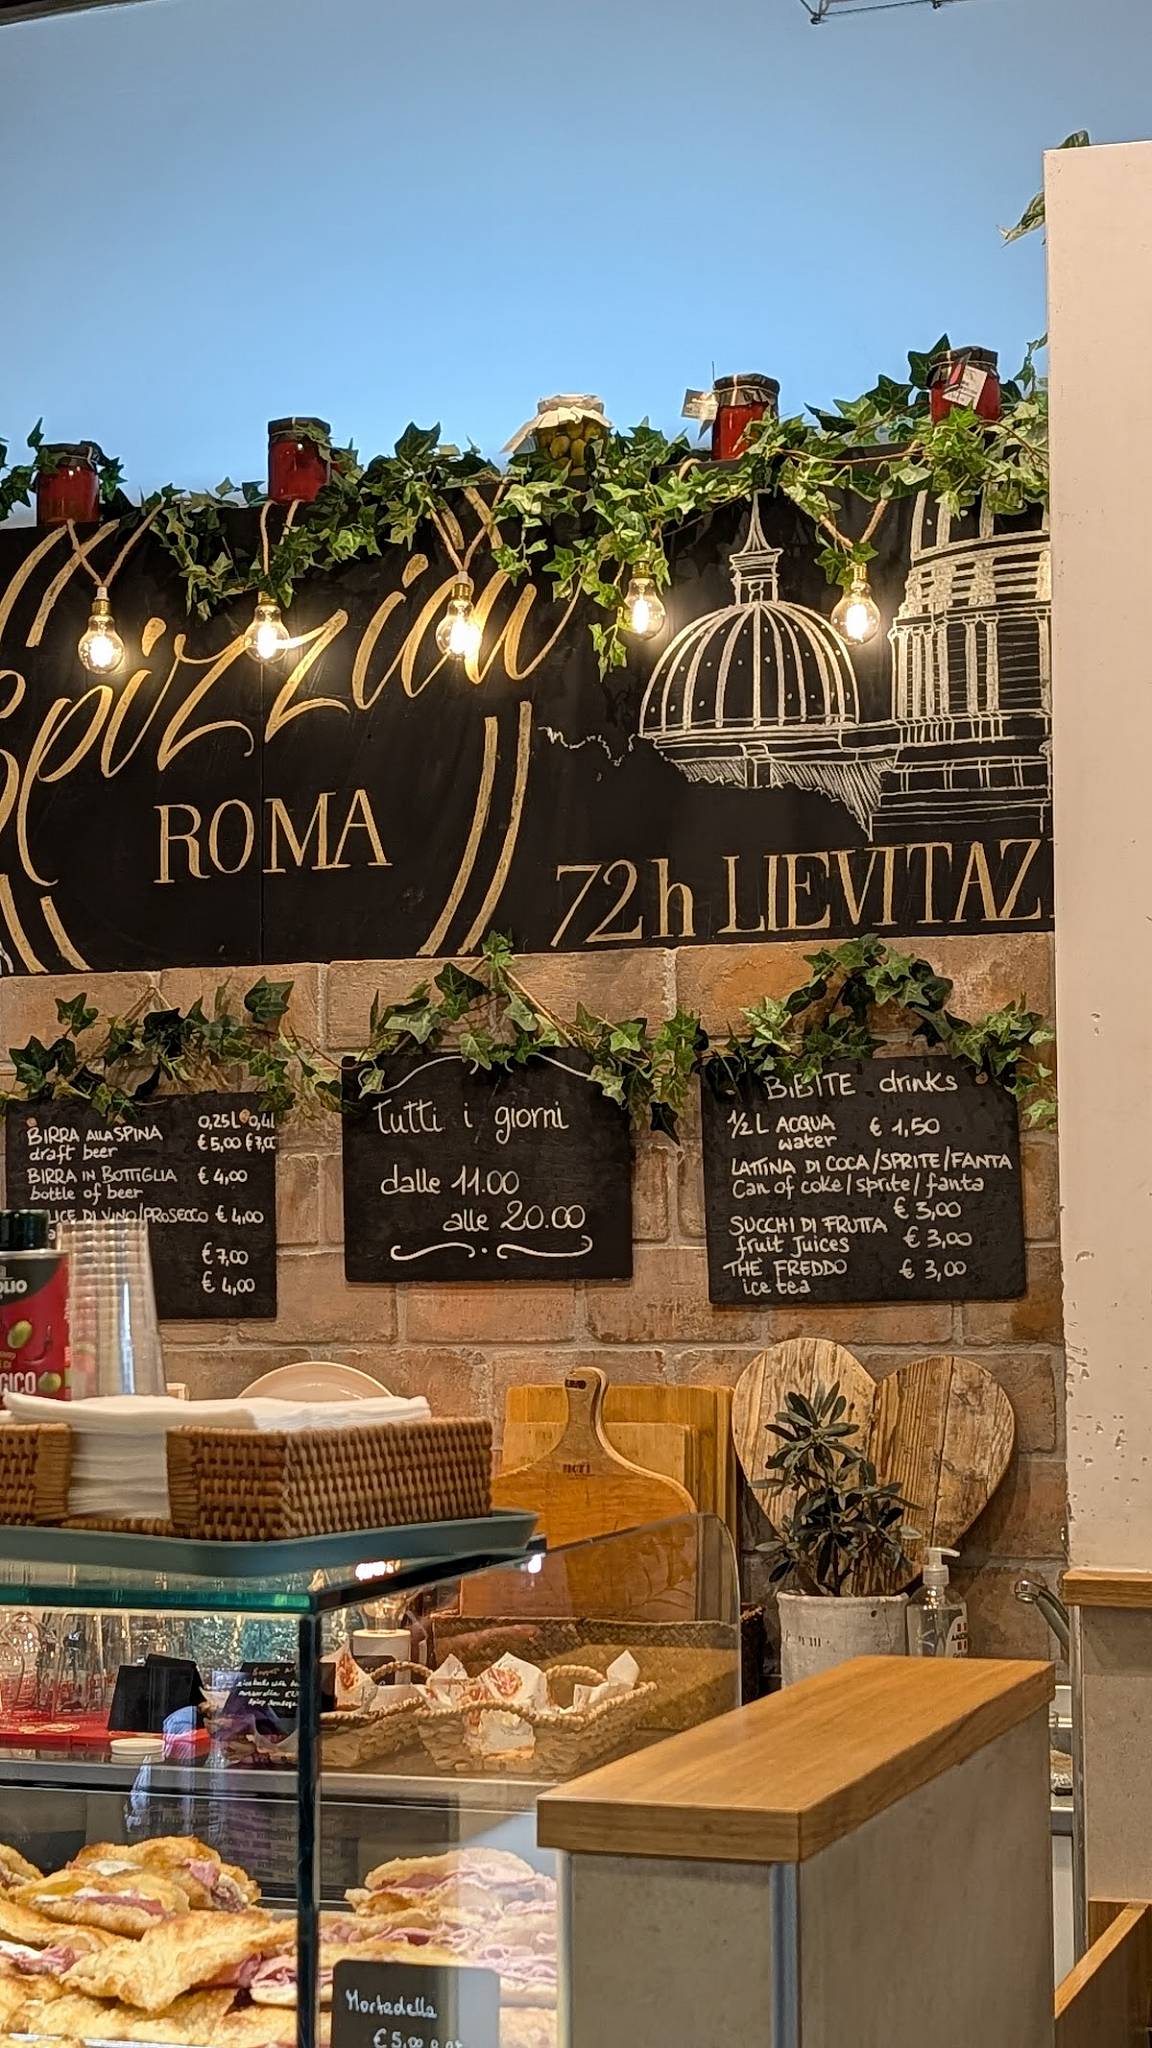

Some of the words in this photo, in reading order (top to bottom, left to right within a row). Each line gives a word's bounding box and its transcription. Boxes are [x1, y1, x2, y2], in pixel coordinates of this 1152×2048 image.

[0, 553, 584, 887] pizzica
[154, 788, 393, 884] ROMA
[716, 838, 1055, 935] LIEVITAZ
[463, 1102, 474, 1128] i
[495, 1101, 570, 1145] giorni
[775, 1114, 836, 1134] ACQUA
[27, 1126, 80, 1146] BIRRA
[116, 1125, 164, 1143] SPINA
[778, 1133, 837, 1151] water
[29, 1145, 72, 1165] draft
[83, 1145, 118, 1159] beer
[27, 1168, 78, 1185] BIRRA
[82, 1170, 97, 1182] IN
[101, 1166, 178, 1183] BOTTIGLIA
[731, 1156, 796, 1177] LATTINA
[805, 1159, 821, 1174] DI
[380, 1164, 441, 1195] dalle
[451, 1165, 520, 1196] 11.00
[732, 1178, 770, 1200] Can
[775, 1176, 795, 1200] of
[30, 1185, 76, 1201] bottle
[83, 1183, 101, 1205] of
[107, 1185, 143, 1199] beer
[48, 1208, 77, 1224] LICE
[82, 1209, 97, 1223] DI
[442, 1209, 490, 1232] alle
[500, 1200, 586, 1231] 20.00
[729, 1215, 795, 1236] SUCCHI
[802, 1216, 818, 1233] DI
[821, 1214, 888, 1234] FRUTTA
[736, 1236, 785, 1261] fruit
[773, 1259, 847, 1278] FREDDO
[743, 1279, 772, 1296] ice
[776, 1279, 811, 1295] tea
[346, 1989, 438, 2019] Mortadella
